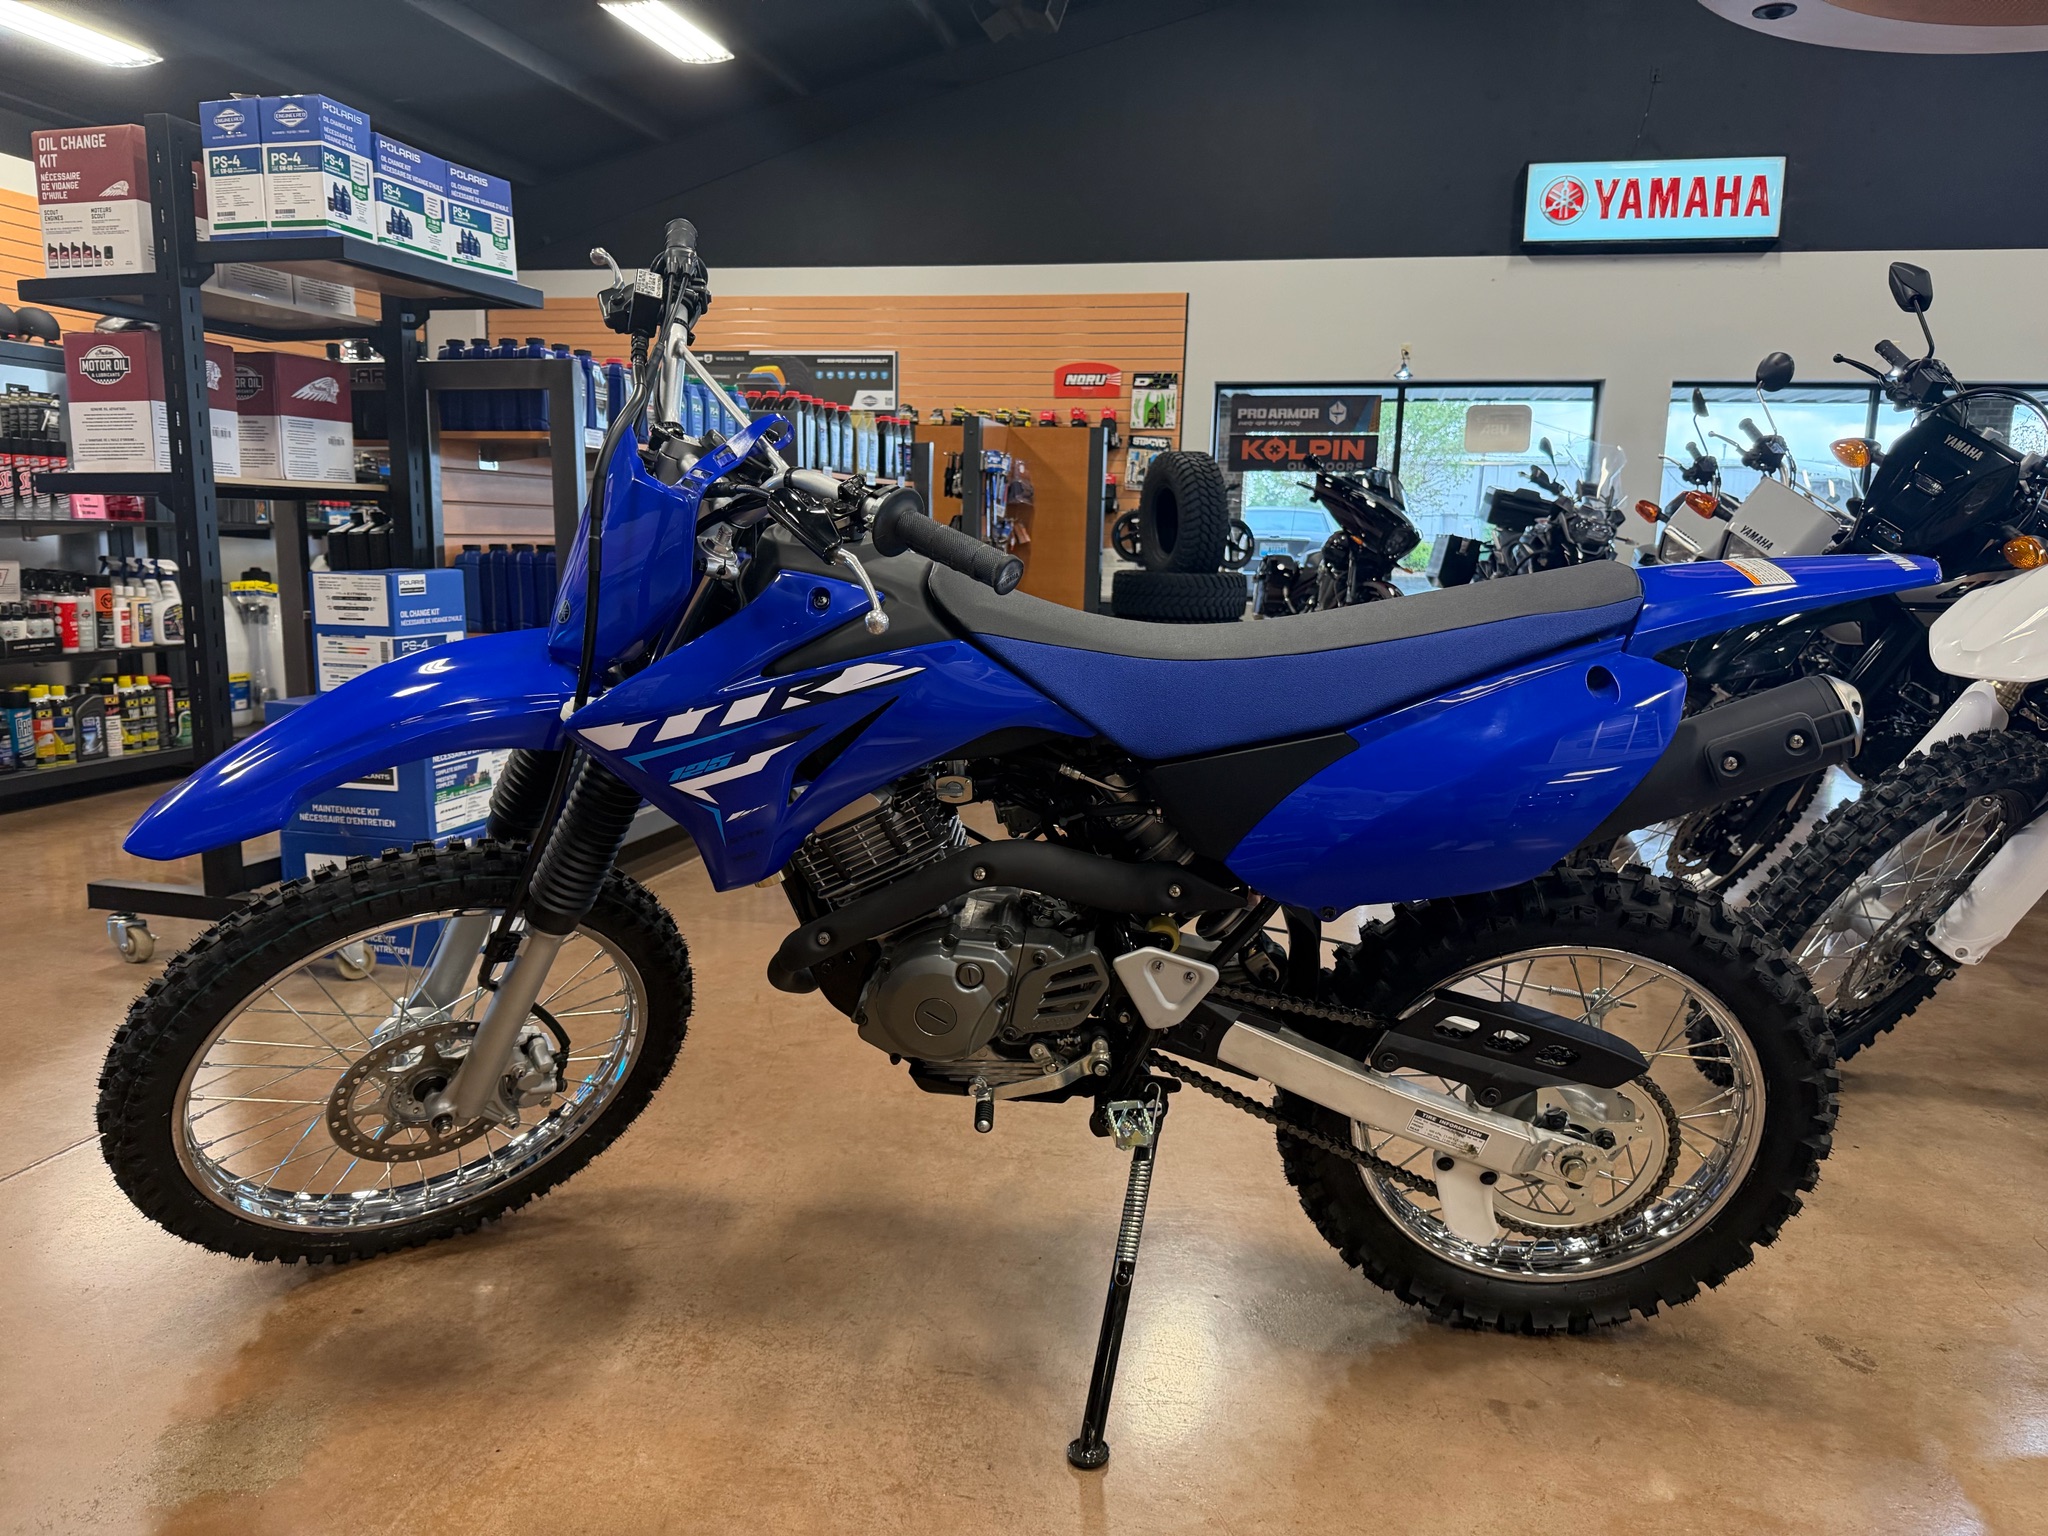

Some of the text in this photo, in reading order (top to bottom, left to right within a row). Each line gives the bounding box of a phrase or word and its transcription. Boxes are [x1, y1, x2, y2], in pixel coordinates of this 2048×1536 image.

[322, 102, 362, 125] POLARIS
[330, 118, 346, 130] CHANGE
[39, 134, 106, 151] OIL CHANGE
[270, 152, 301, 166] PS-4
[380, 140, 421, 164] POLARIS
[39, 154, 58, 168] KIT
[212, 155, 240, 168] PS-4
[324, 152, 344, 169] PS-4
[40, 172, 81, 181] NÉCESSAIRE
[450, 167, 488, 187] POLARIS
[51, 181, 79, 190] VIDANGE
[382, 182, 401, 198] PS-4
[42, 191, 68, 200] D'HUILE
[1594, 174, 1770, 219] YAMAHA
[452, 206, 470, 220] PS-4
[82, 359, 128, 372] MOTOR OIL
[248, 378, 261, 388] OIL
[1065, 374, 1106, 386] NORU
[1237, 408, 1320, 419] PRO ARMOR
[1241, 437, 1365, 463] KOLPIN
[1944, 434, 1984, 461] YAMAHA
[1287, 462, 1363, 471] OUOORS
[1740, 525, 1774, 550] YAMAHA
[409, 609, 430, 617] CHANGE
[402, 640, 428, 651] PS-4
[669, 752, 735, 782] 125
[312, 804, 380, 816] MAINTENANCE KIT
[299, 812, 396, 828] NÉCESSAIRE D'ENTRETIEN
[1422, 1113, 1482, 1137] TIRE INFORMATION
